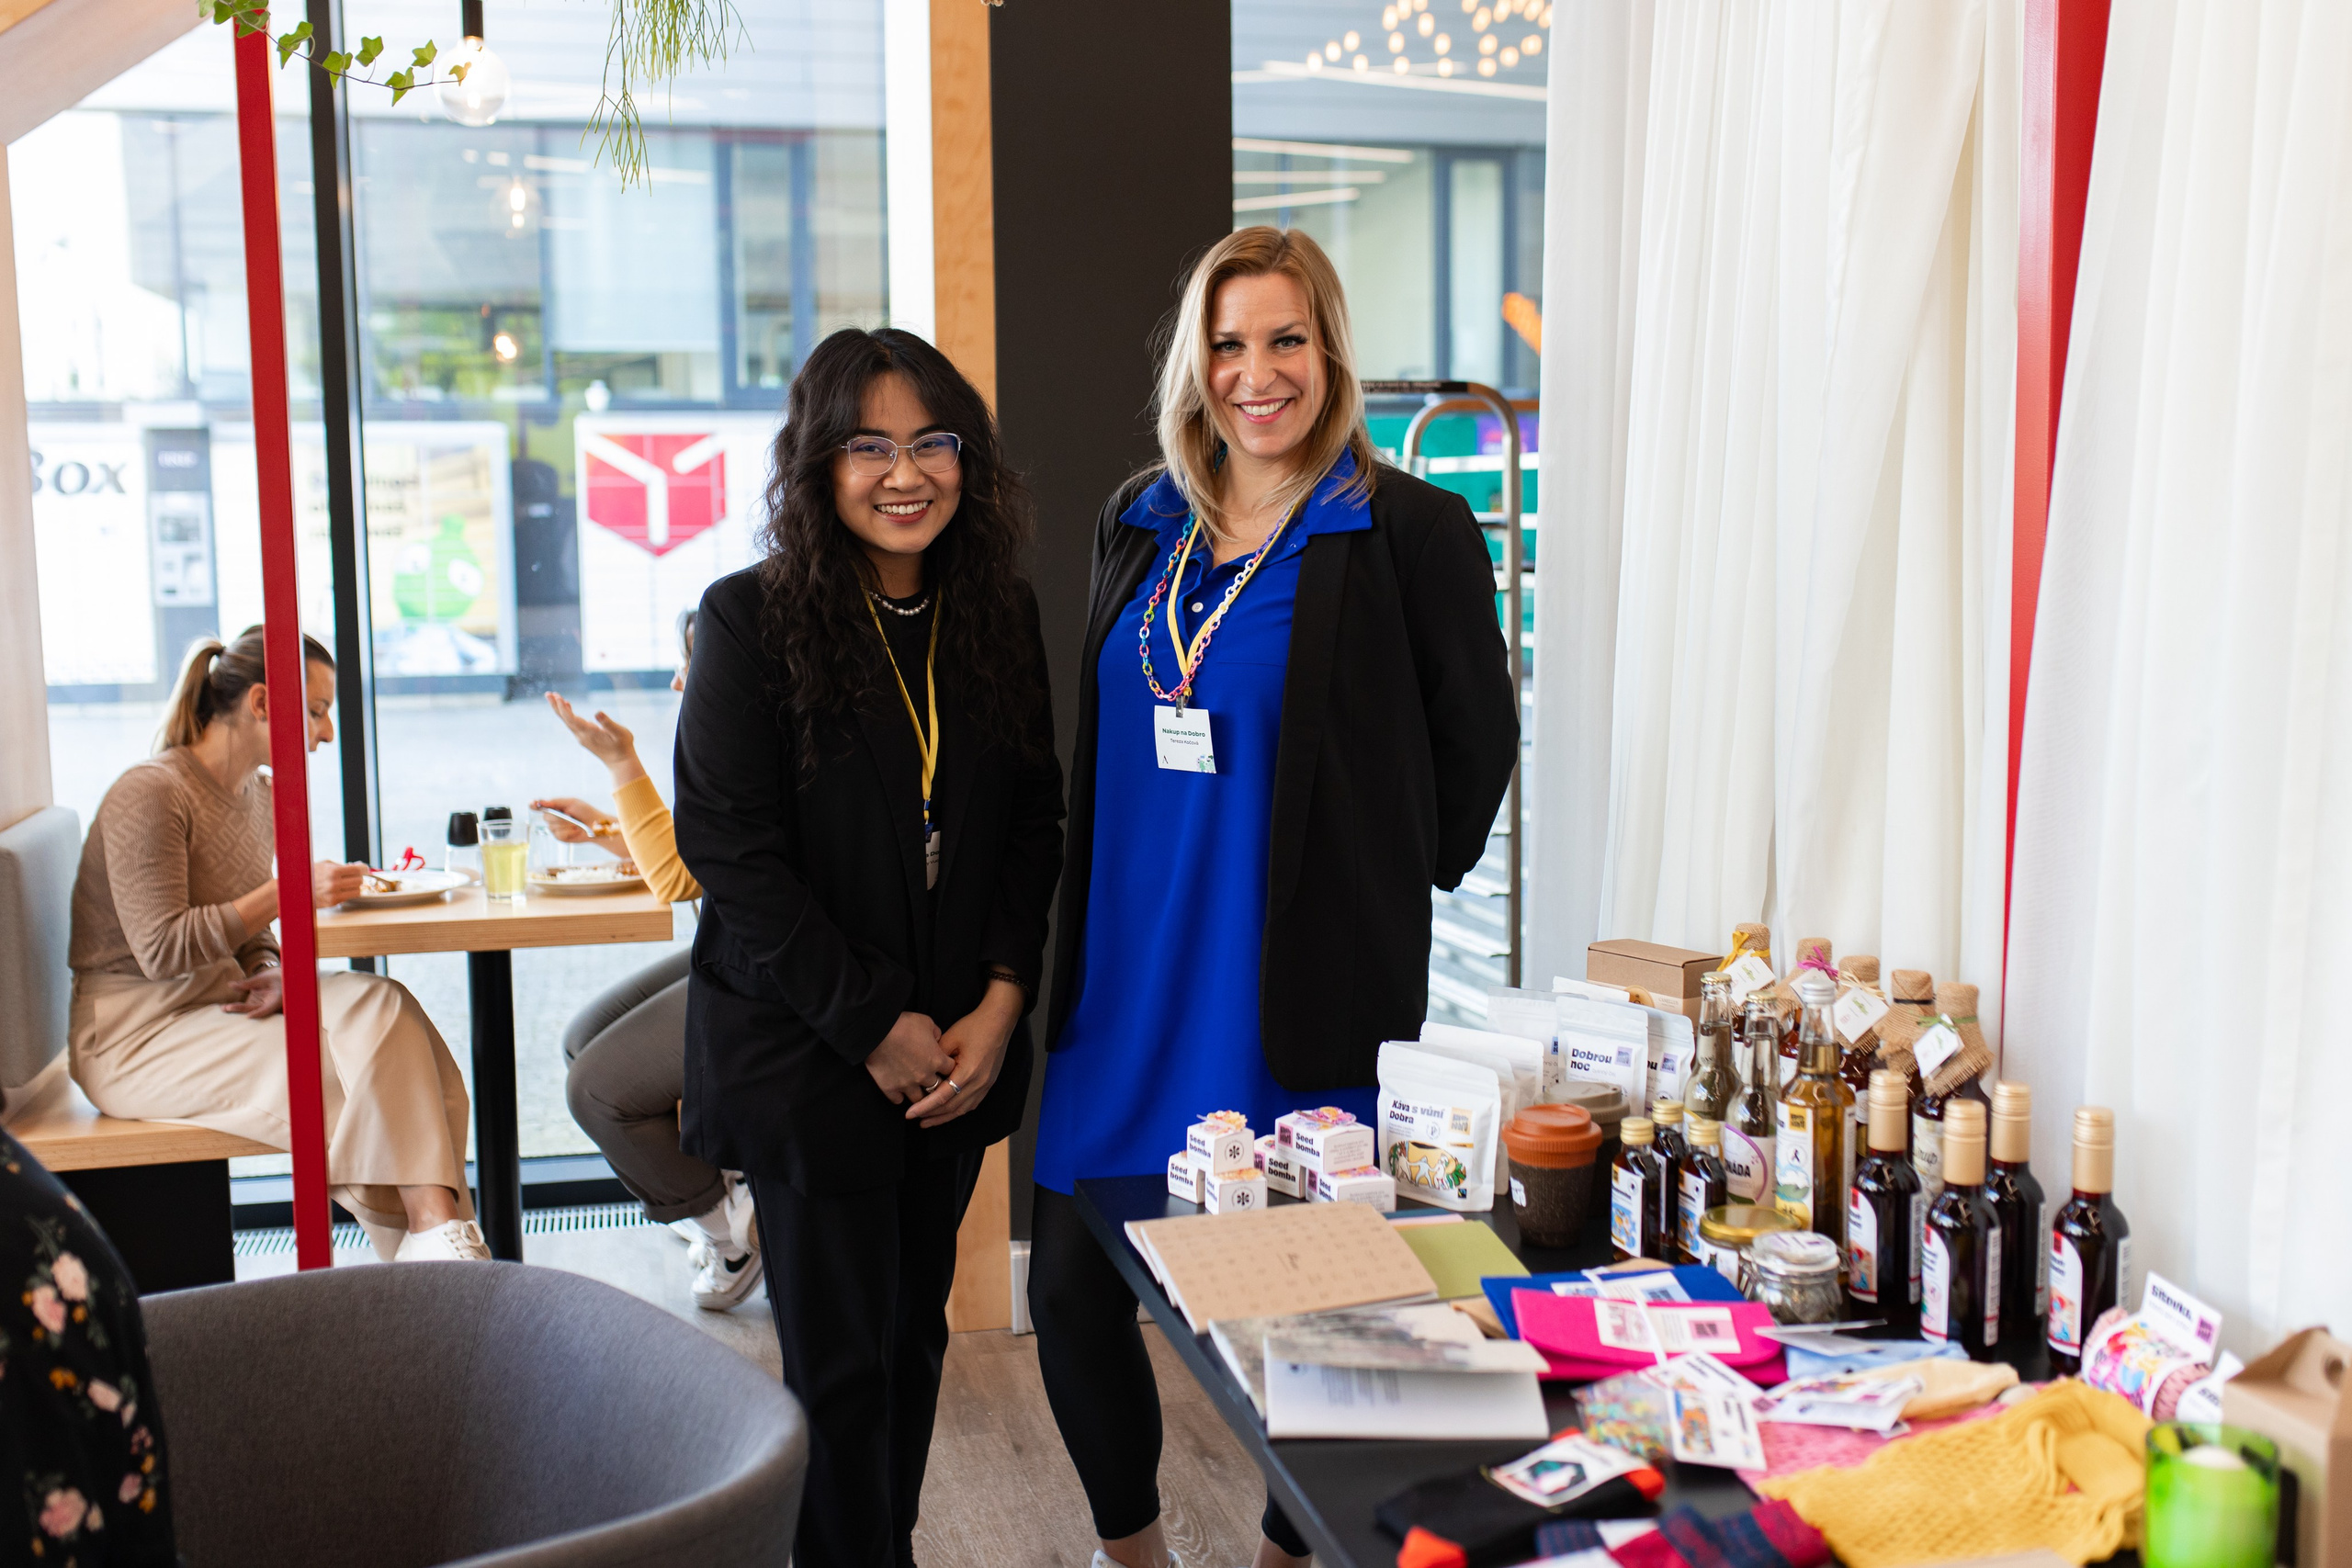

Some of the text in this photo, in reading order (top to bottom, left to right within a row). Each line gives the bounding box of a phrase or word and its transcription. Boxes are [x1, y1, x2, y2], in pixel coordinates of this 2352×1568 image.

[1571, 1048, 1612, 1065] Dobrou
[1570, 1060, 1590, 1072] noc
[1392, 1100, 1410, 1112] Káva
[1411, 1106, 1418, 1114] s
[1389, 1111, 1414, 1124] Dobra
[1189, 1134, 1205, 1146] Seed
[1295, 1133, 1314, 1145] Seed
[1189, 1143, 1212, 1158] bomba
[1295, 1142, 1320, 1157] bomba
[1170, 1163, 1188, 1175] Seed
[1269, 1157, 1289, 1170] Seed
[1170, 1171, 1193, 1186] bomba
[1268, 1167, 1296, 1182] bomba
